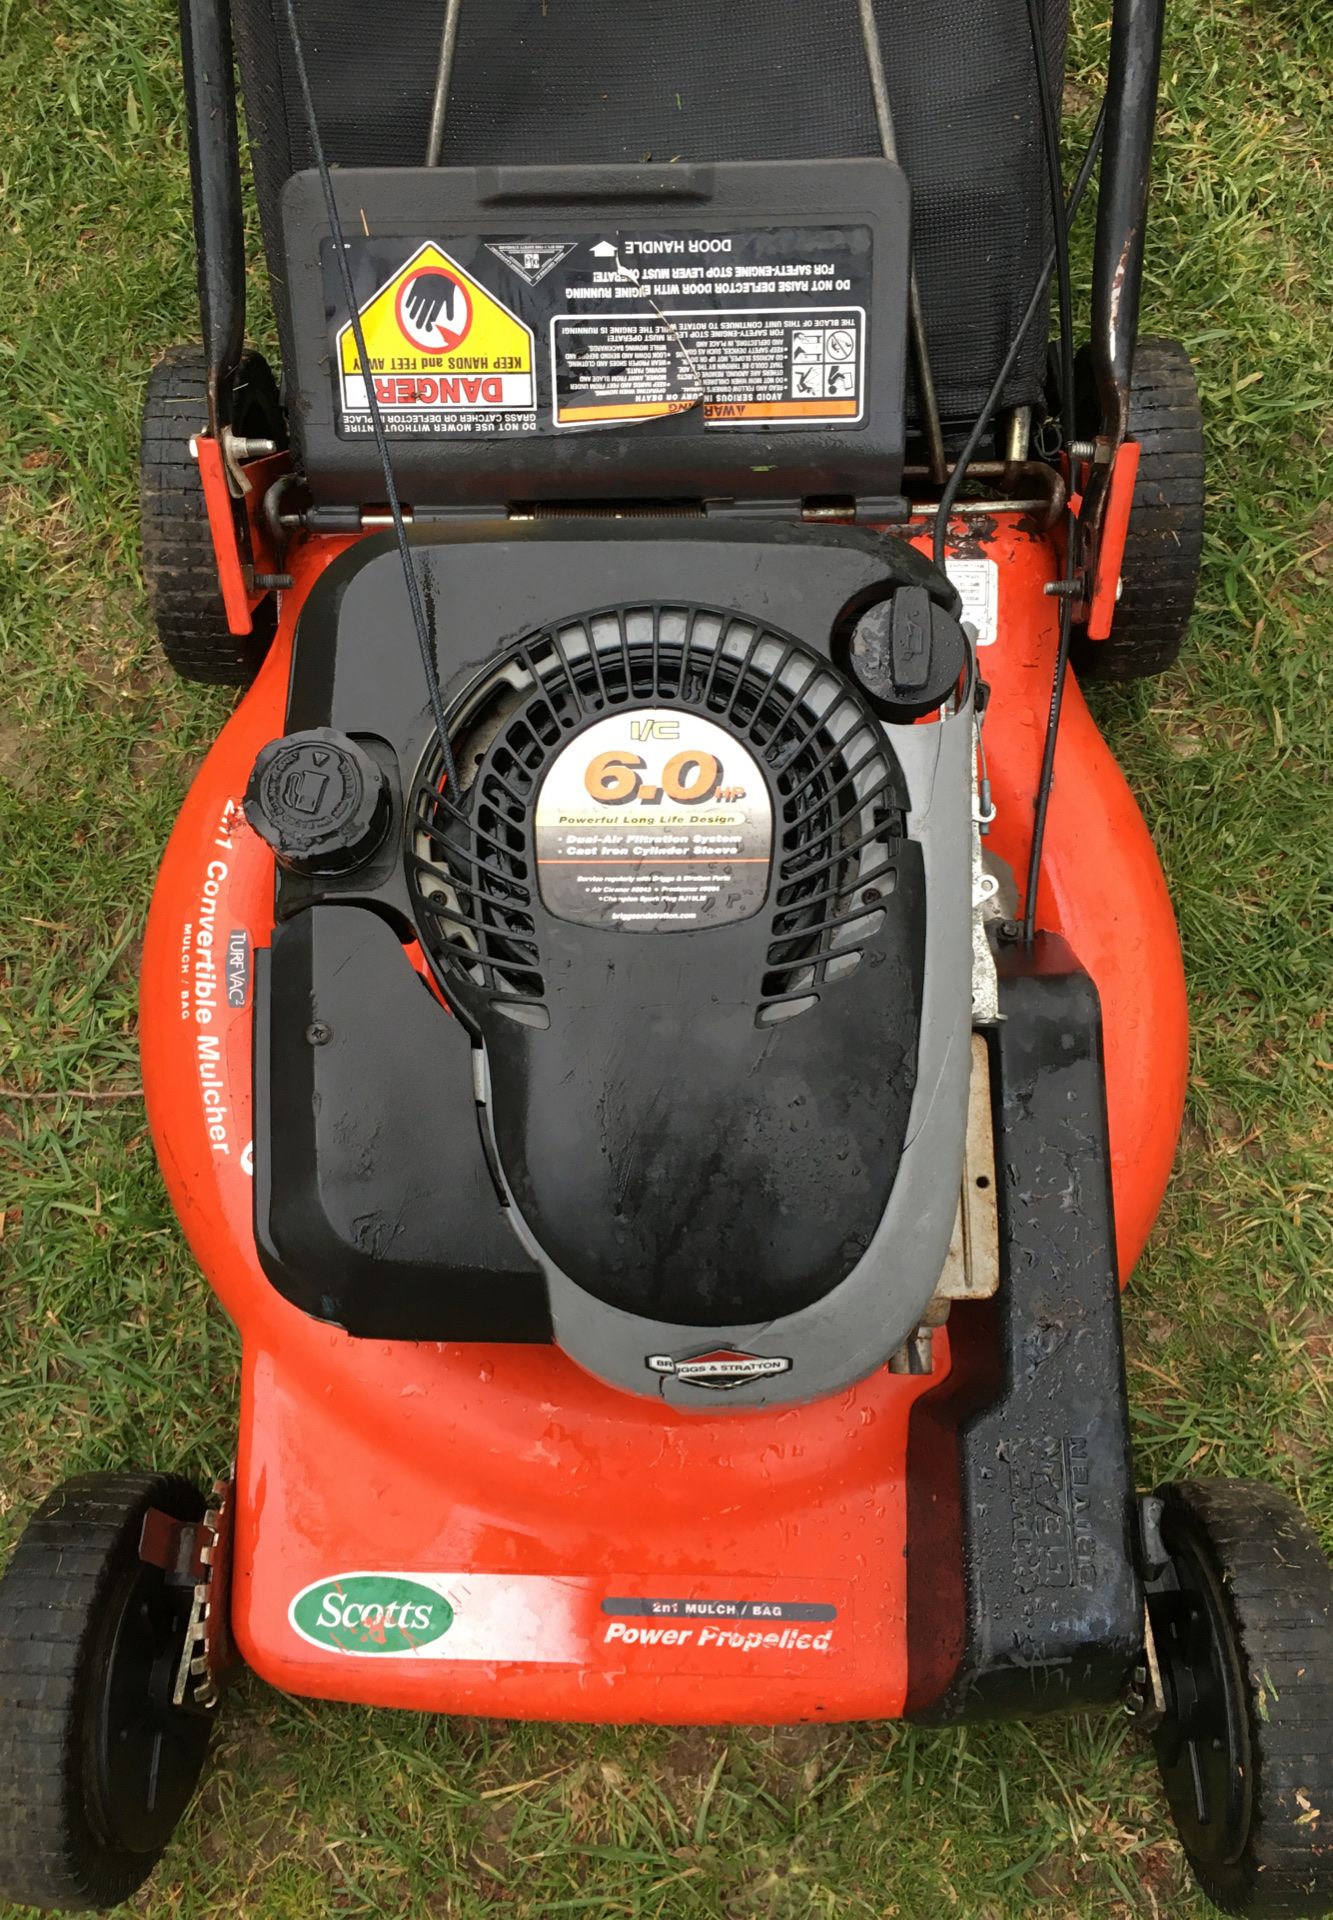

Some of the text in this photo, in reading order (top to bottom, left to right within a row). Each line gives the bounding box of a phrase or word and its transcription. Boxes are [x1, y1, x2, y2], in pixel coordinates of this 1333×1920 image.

[625, 240, 731, 254] DOOR HANDLE
[642, 268, 670, 279] MUST
[672, 268, 704, 278] LEVER
[706, 267, 732, 278] STOP
[735, 265, 812, 277] SAFETY-ENGINE
[814, 264, 835, 275] FOR
[654, 284, 679, 295] WITH
[682, 283, 712, 294] DOOR
[714, 282, 775, 293] DEFLECTOR
[779, 281, 809, 292] RAISE
[811, 280, 832, 291] NOT
[835, 280, 850, 290] DO
[566, 288, 612, 298] RUNNING
[710, 330, 768, 338] SAFETY-ENGINE
[353, 357, 522, 370] KEEP HANDS and FEET AWY
[374, 377, 503, 404] DANGER
[716, 394, 753, 402] SERIOUS
[756, 393, 782, 401] AVOID
[388, 415, 441, 423] DEFLECTOR
[444, 415, 457, 423] OR
[460, 414, 502, 423] CATCHER
[505, 413, 536, 422] GRASS
[384, 424, 430, 432] WITHOUT
[433, 423, 471, 432] MOWER
[475, 423, 494, 431] USE
[498, 422, 518, 431] NOT
[522, 422, 536, 431] DO
[584, 750, 747, 806] 6.0 HP
[559, 816, 618, 824] Powerful
[623, 816, 654, 825] Long
[689, 816, 736, 825] Design
[566, 834, 742, 844] Dual-Air Filtration System
[566, 846, 738, 856] Cast Iron Cylinder Sleeve
[181, 924, 192, 973] MULCH
[181, 991, 190, 1020] BAG
[195, 861, 230, 1155] Convertible Mulcher
[721, 1362, 781, 1371] STRATTON
[316, 1592, 433, 1629] Scotts
[653, 1602, 782, 1617] 2n1 MULCH / BAG
[604, 1623, 692, 1646] Power
